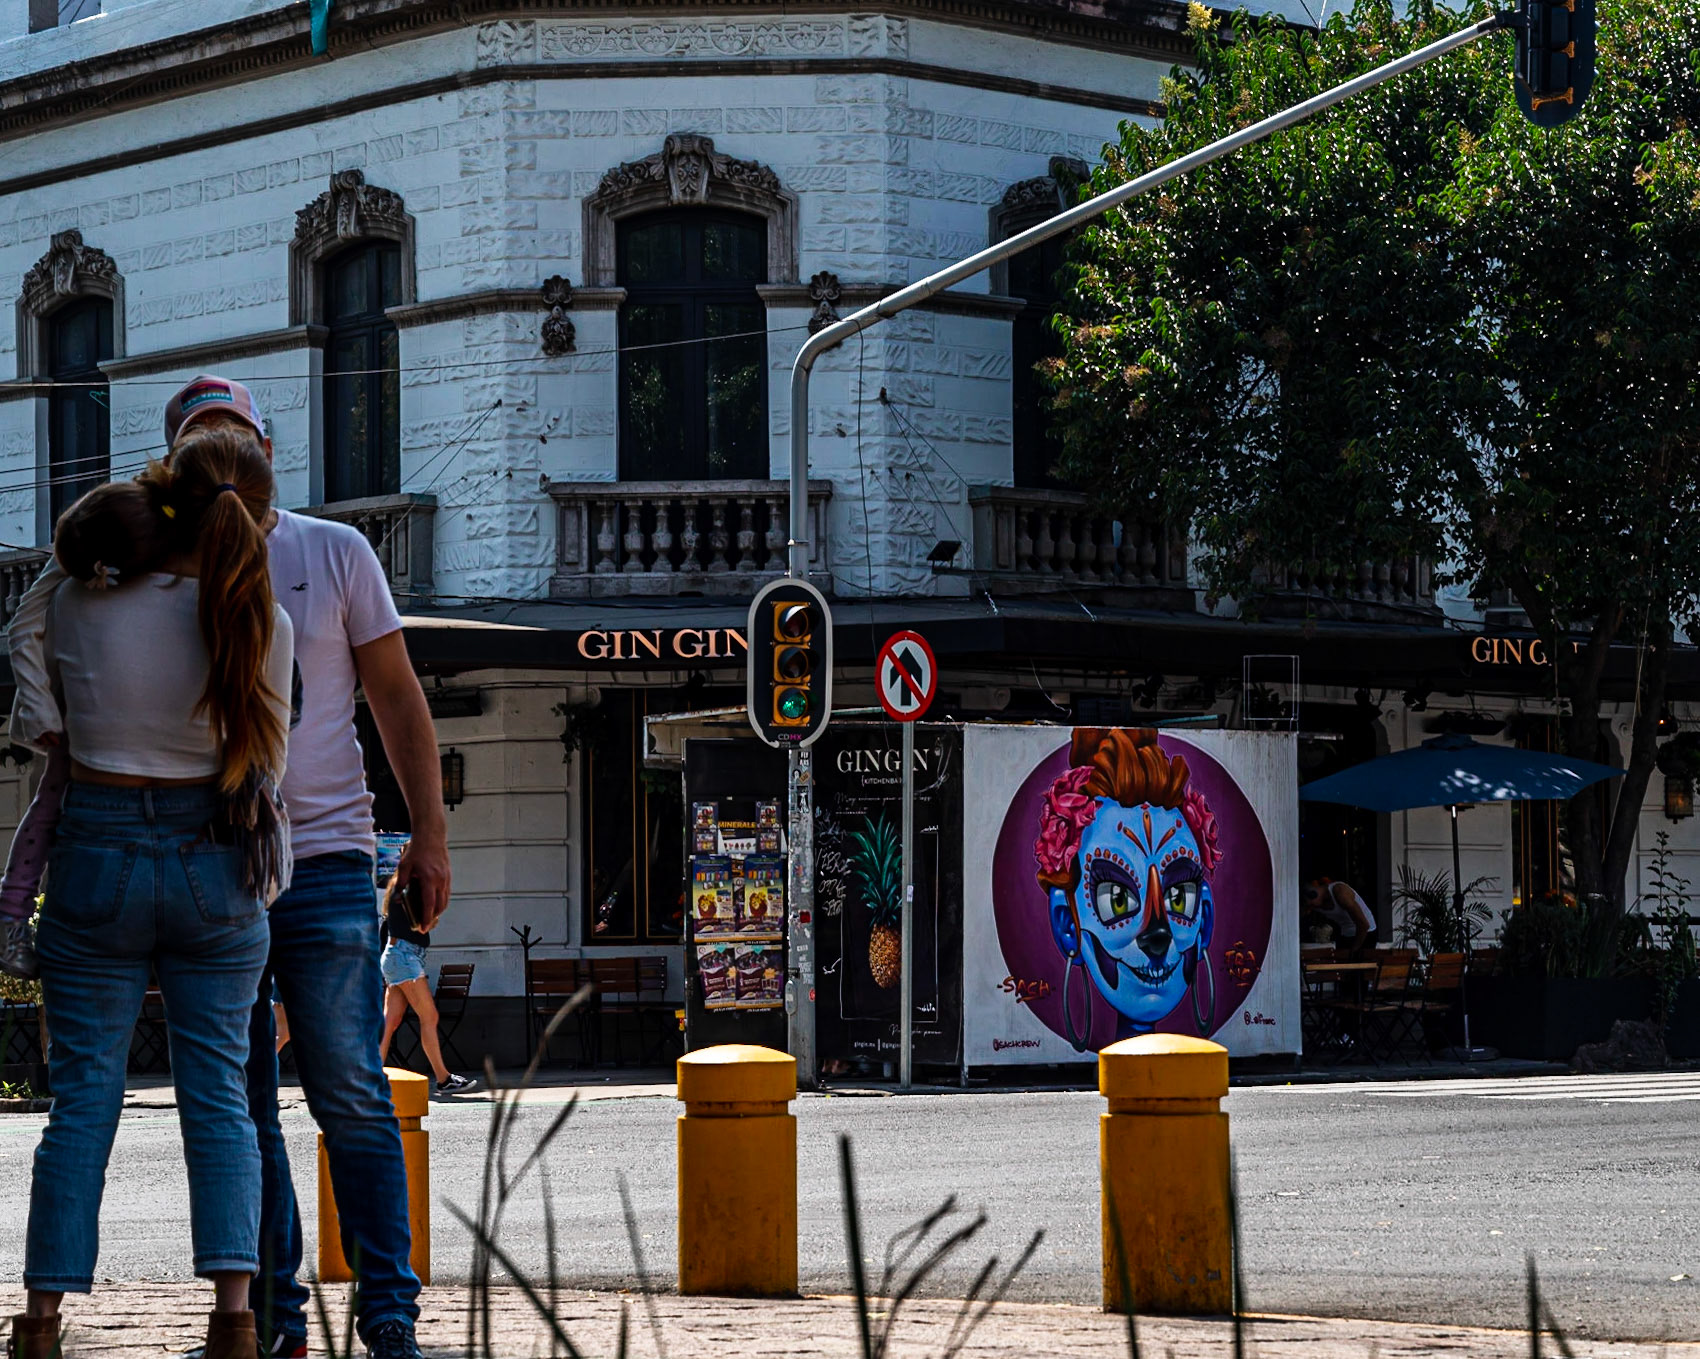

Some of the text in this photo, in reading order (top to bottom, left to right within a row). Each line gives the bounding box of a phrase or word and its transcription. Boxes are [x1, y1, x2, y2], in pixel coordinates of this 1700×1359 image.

[577, 630, 664, 659] GIN
[1471, 636, 1522, 665] GIN
[777, 733, 802, 741] CDMX
[836, 749, 929, 773] GINGN
